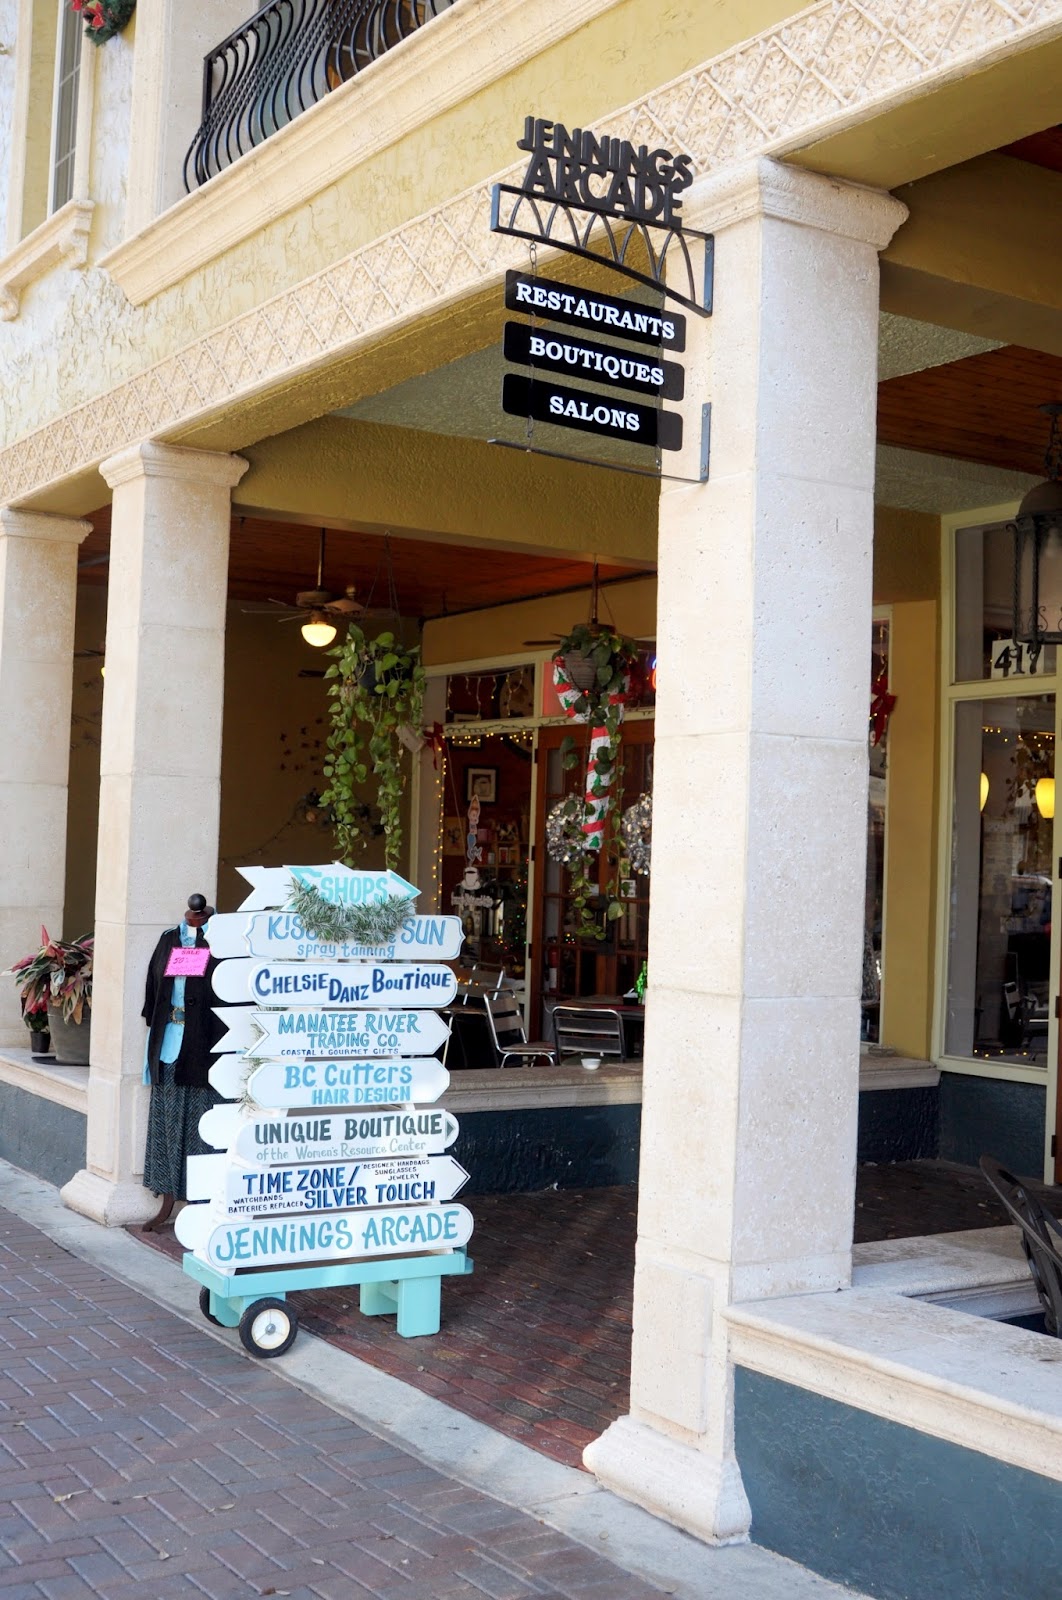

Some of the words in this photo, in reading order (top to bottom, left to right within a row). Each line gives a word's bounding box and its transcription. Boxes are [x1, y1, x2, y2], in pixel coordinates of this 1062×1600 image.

[517, 116, 694, 192] JENNINGS
[522, 151, 682, 230] ARCADE
[515, 282, 675, 339] RESTAURANTS
[529, 336, 664, 386] BOUTIQUES
[549, 396, 640, 431] SALONS
[994, 645, 1042, 678] 417
[320, 876, 388, 904] SHOPS
[401, 918, 446, 946] SUN
[297, 943, 336, 958] spray
[341, 943, 395, 958] tanning
[328, 978, 369, 1003] DANZ
[278, 1013, 358, 1034] MANATEE
[365, 1013, 421, 1034] RIVER
[307, 1032, 370, 1049] TRADING
[377, 1033, 401, 1048] CO.
[328, 1048, 369, 1056] GOURMET
[324, 1063, 413, 1087] Cutters
[312, 1088, 350, 1105] HAIR
[354, 1086, 411, 1103] DESIGN
[255, 1119, 331, 1145] UNIQUE
[344, 1114, 442, 1141] BOUTIQUE
[256, 1148, 270, 1161] of
[271, 1148, 289, 1160] the
[340, 1142, 387, 1157] Resource
[389, 1138, 427, 1152] Center
[375, 1167, 417, 1175] SUNGLASSES
[388, 1173, 420, 1181] JEWELRY
[228, 1204, 267, 1213] BATTERIES
[270, 1201, 303, 1210] REPLACED
[233, 1194, 284, 1204] WATCHBANDS
[304, 1186, 368, 1209] SILVER
[375, 1180, 435, 1203] TOUCH
[361, 1211, 460, 1249] ARCADE
